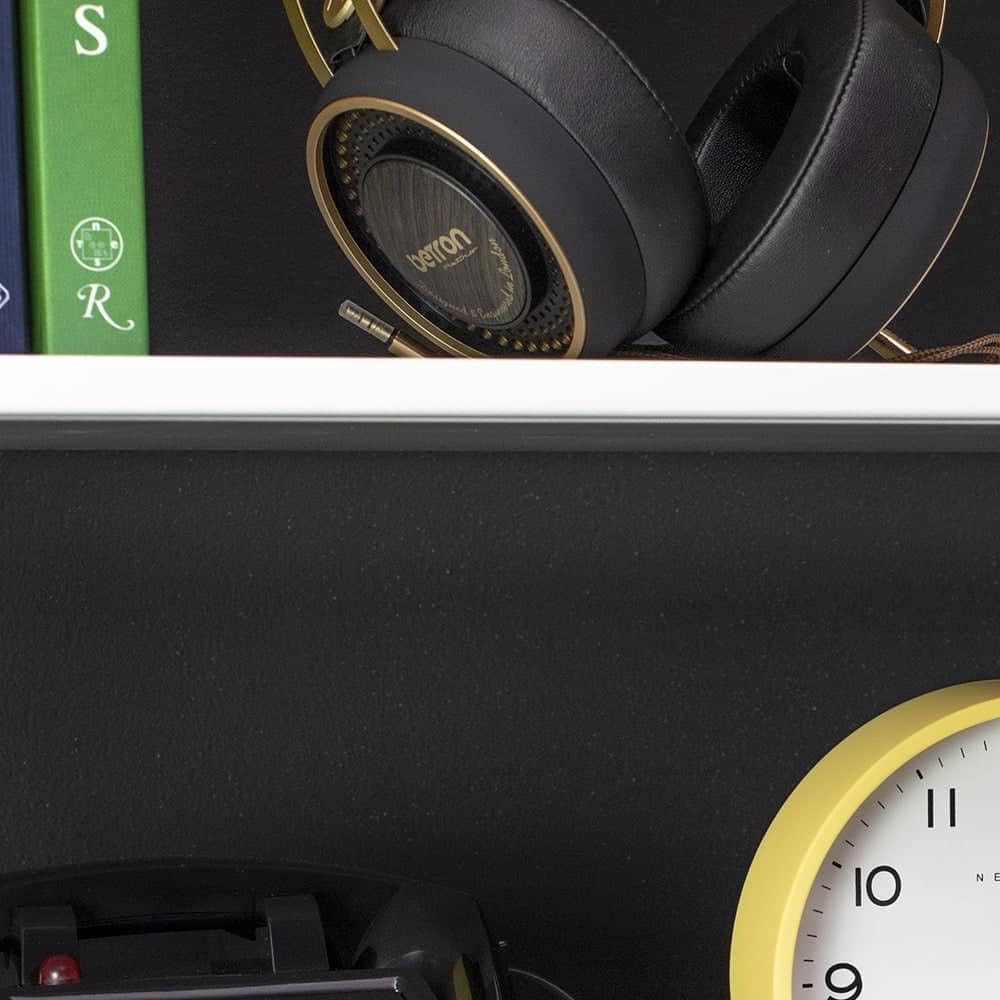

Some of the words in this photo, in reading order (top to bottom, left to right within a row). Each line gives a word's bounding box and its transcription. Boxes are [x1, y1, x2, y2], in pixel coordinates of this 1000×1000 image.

[74, 4, 108, 56] S
[77, 283, 135, 331] R
[927, 787, 956, 829] 11
[854, 865, 902, 907] 10
